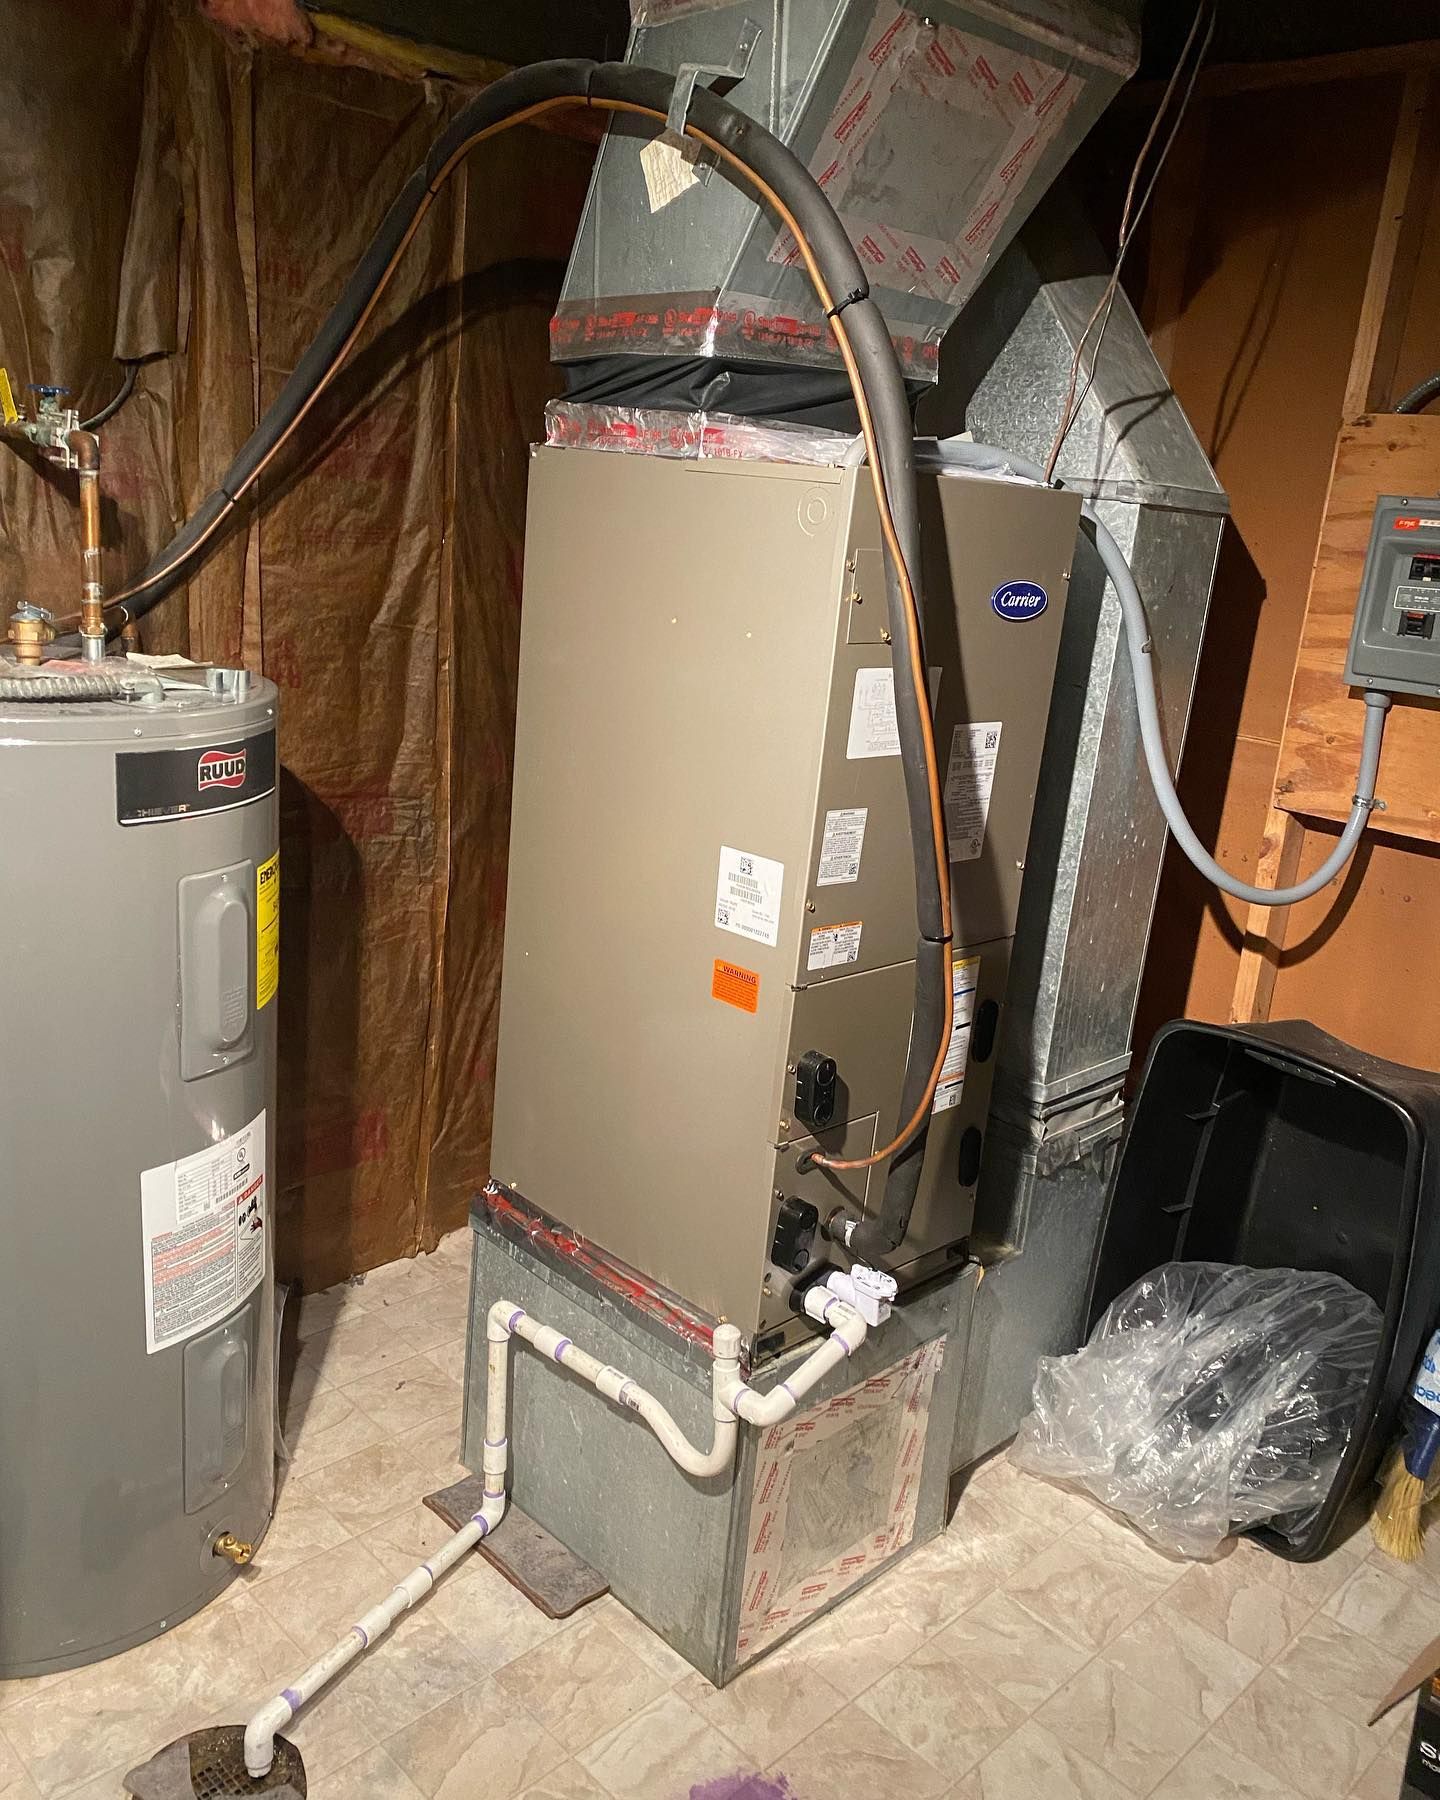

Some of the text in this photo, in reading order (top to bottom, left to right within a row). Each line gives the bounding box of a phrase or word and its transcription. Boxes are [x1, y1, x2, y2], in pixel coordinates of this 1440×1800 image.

[1001, 591, 1041, 607] Carrier
[199, 759, 246, 782] RUUD
[723, 965, 757, 985] WARNING
[1420, 1741, 1440, 1760] S
